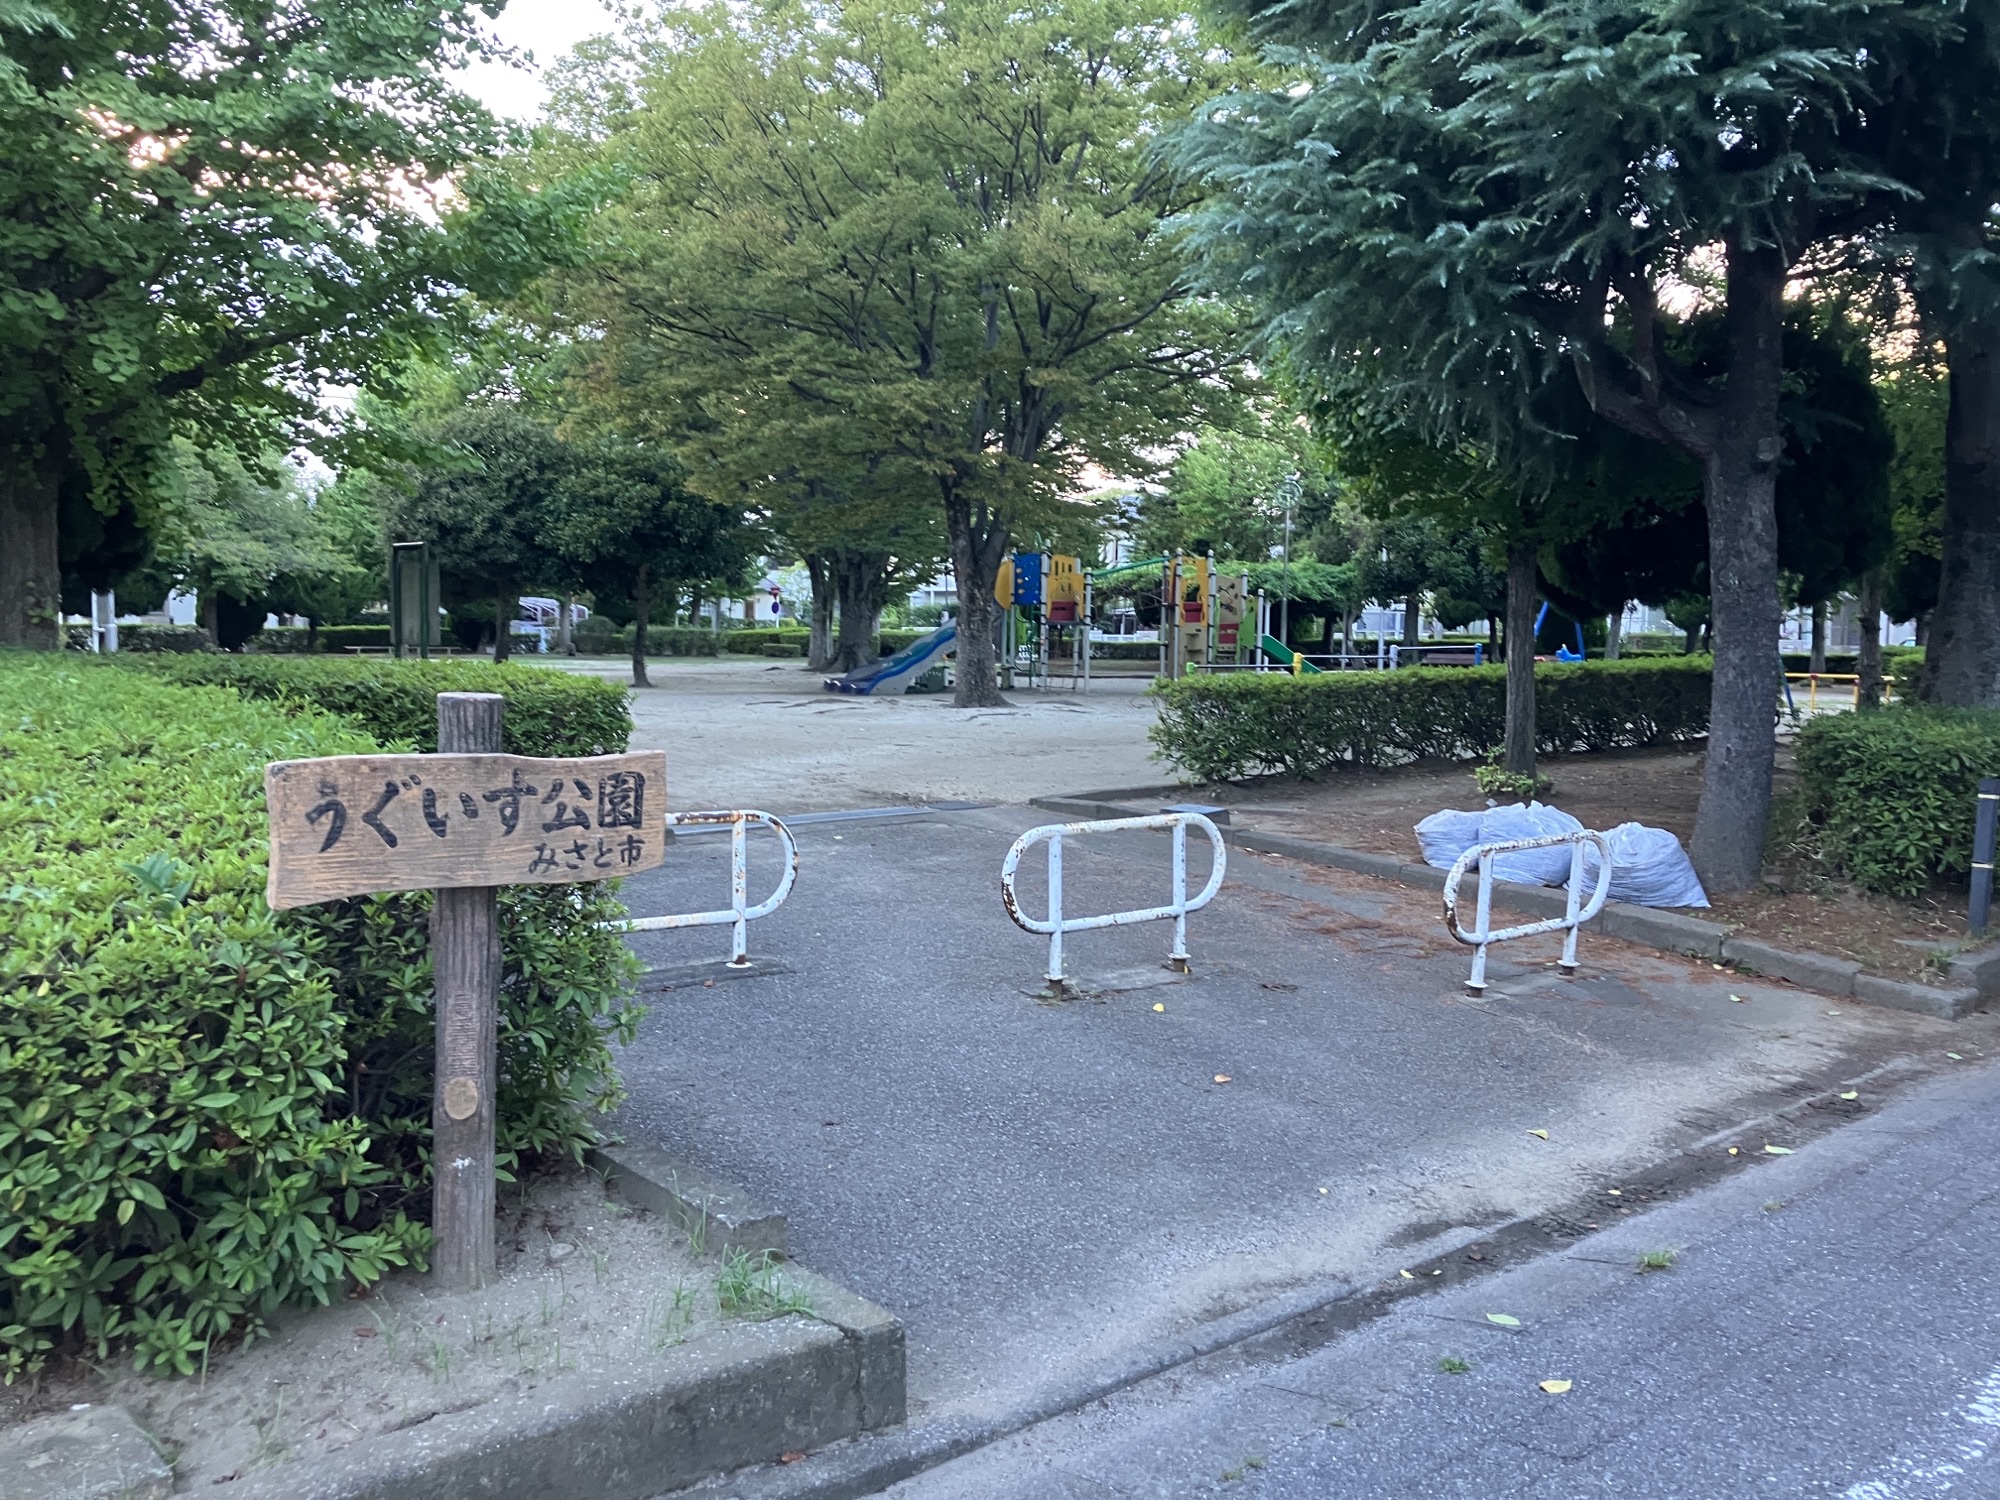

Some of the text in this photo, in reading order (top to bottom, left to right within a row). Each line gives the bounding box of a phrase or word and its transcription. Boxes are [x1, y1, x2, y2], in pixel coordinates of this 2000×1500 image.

[305, 768, 645, 853] うぐいす公園
[529, 834, 645, 874] みさと市
